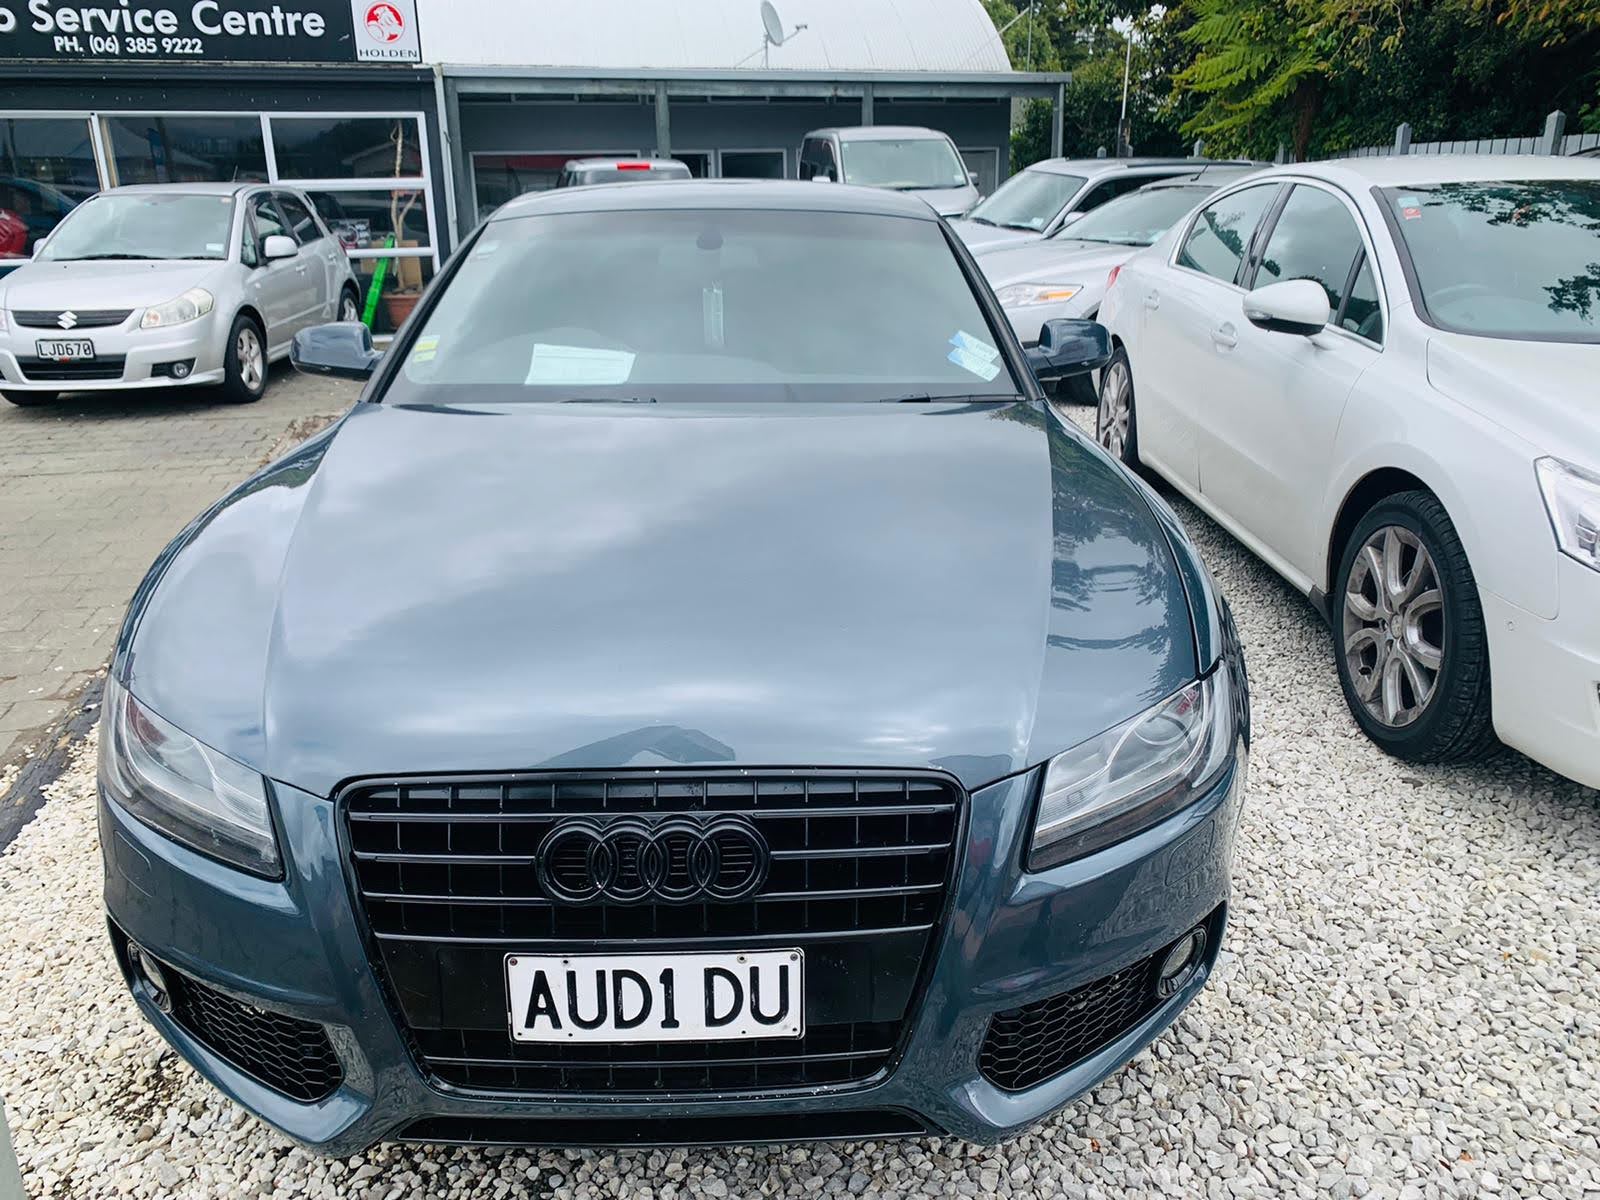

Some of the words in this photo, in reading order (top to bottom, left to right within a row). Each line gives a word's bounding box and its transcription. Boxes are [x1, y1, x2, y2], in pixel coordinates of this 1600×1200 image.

[28, 0, 178, 34] Service
[191, 0, 325, 37] Centre
[53, 35, 84, 52] PH.
[89, 34, 119, 55] (06)
[125, 37, 157, 53] 385
[161, 37, 204, 54] 9222
[359, 49, 418, 58] HOLDEN
